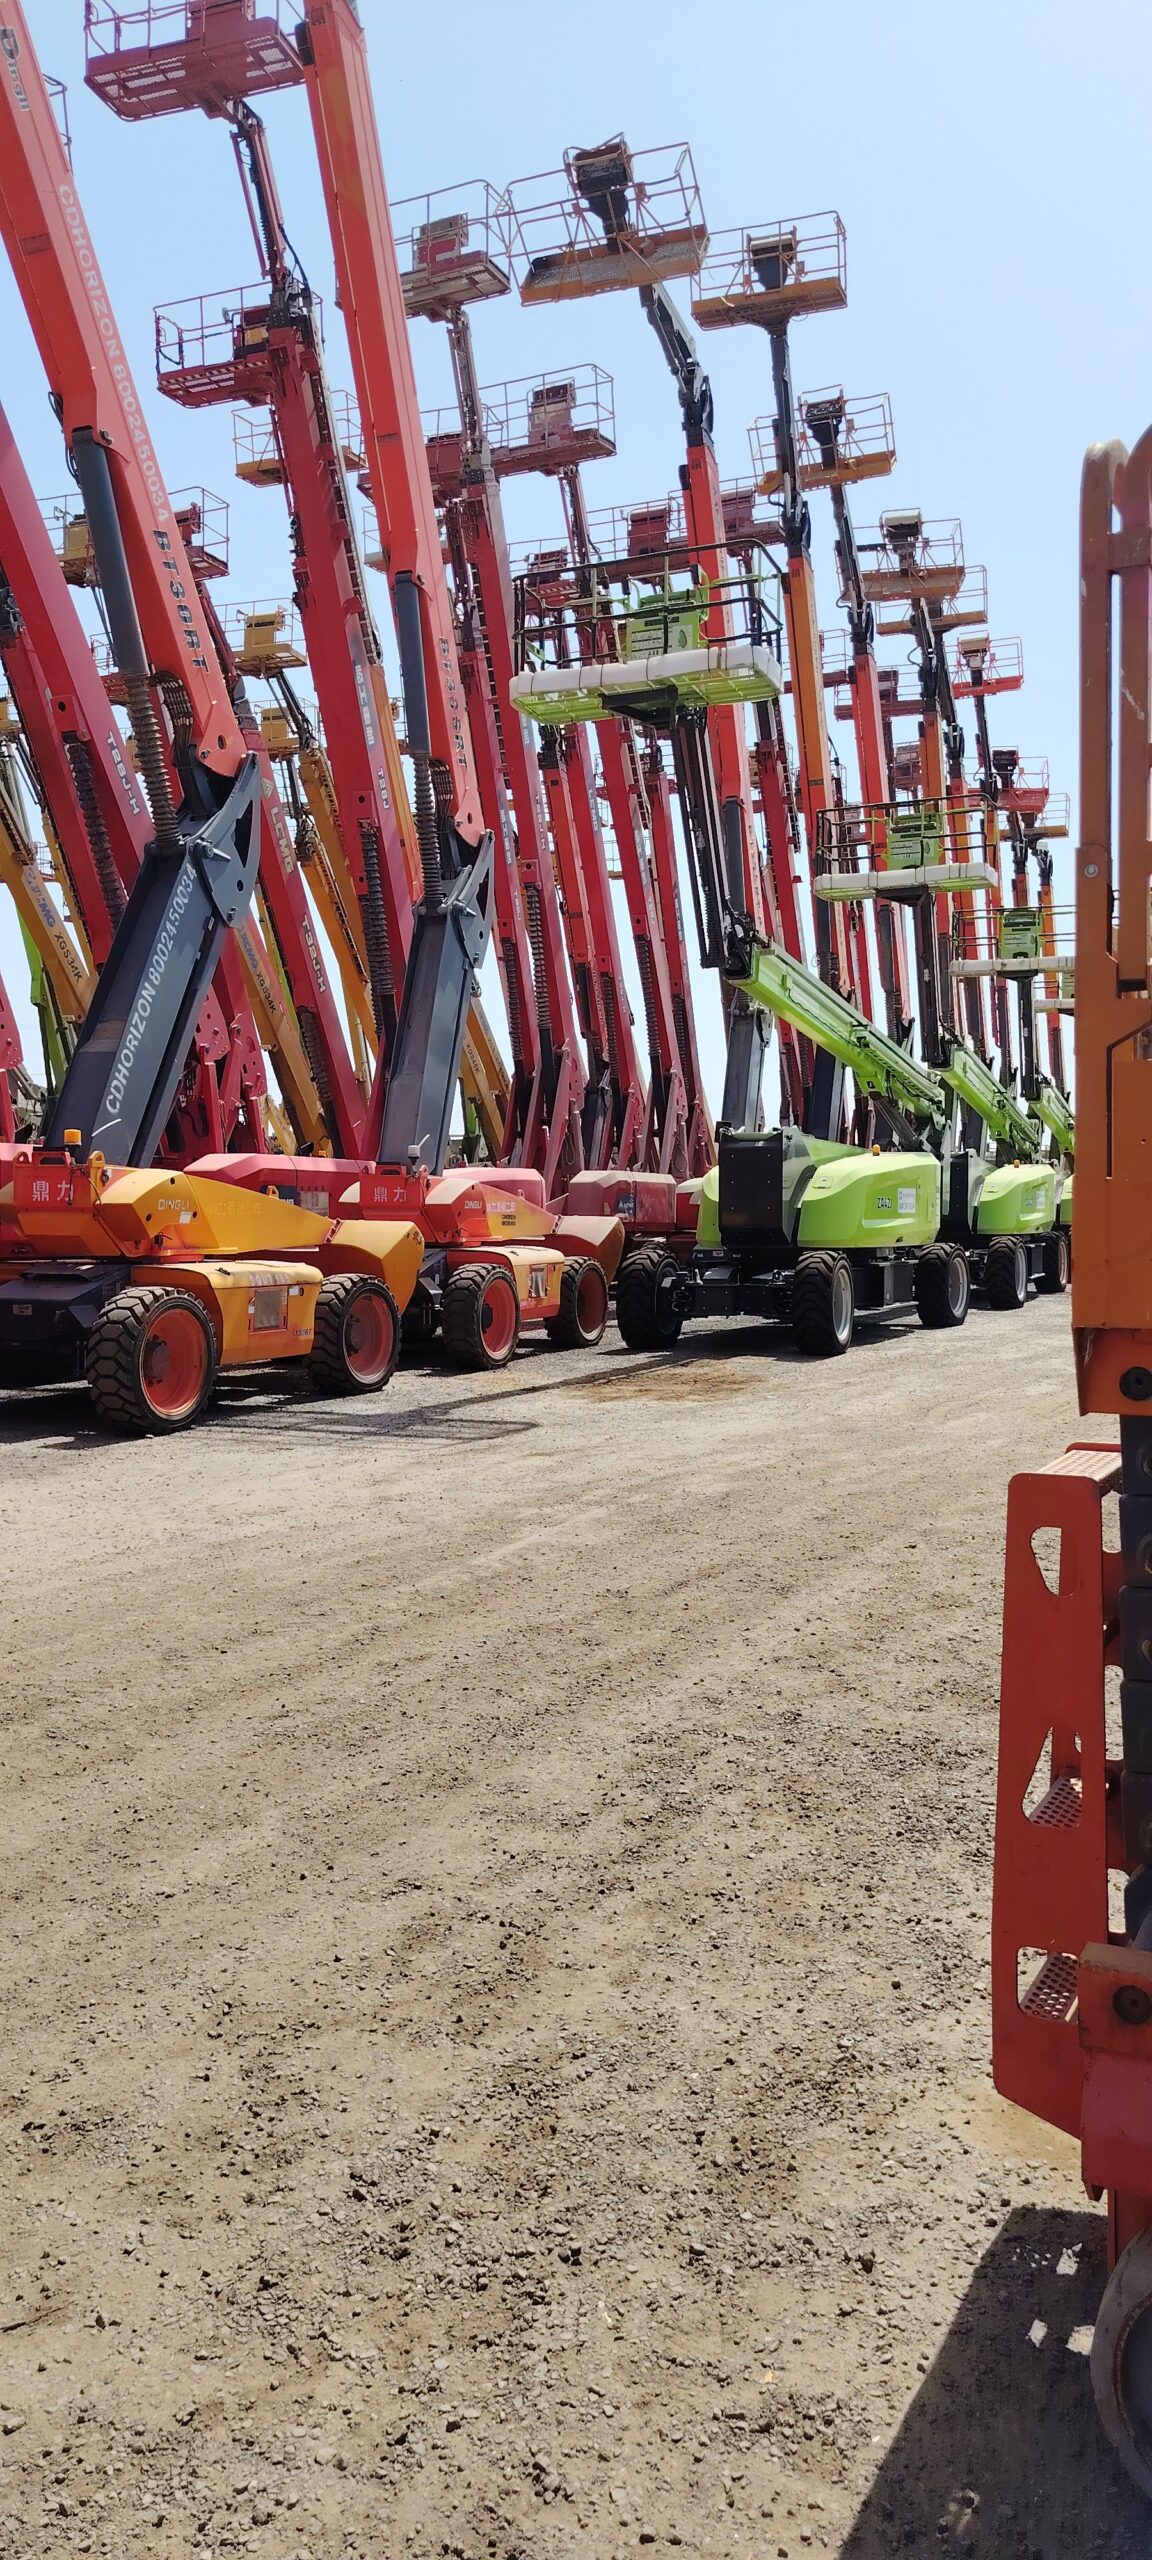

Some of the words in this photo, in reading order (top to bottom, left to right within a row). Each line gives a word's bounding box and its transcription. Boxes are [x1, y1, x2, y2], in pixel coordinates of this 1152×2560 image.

[59, 184, 122, 359] CDHORIZON
[111, 362, 170, 522] 8002450034
[153, 529, 210, 674] BT30RT
[107, 729, 140, 815] T28J-H
[54, 931, 84, 983] XGS34K
[301, 913, 327, 994] T32J-H
[106, 980, 158, 1116] CDHORIZON
[149, 861, 198, 987] 8002450034
[255, 971, 277, 1014] XGS34K
[32, 1180, 74, 1202] 鼎力
[157, 1199, 191, 1211] DINGLI
[373, 1186, 407, 1203] 鼎力
